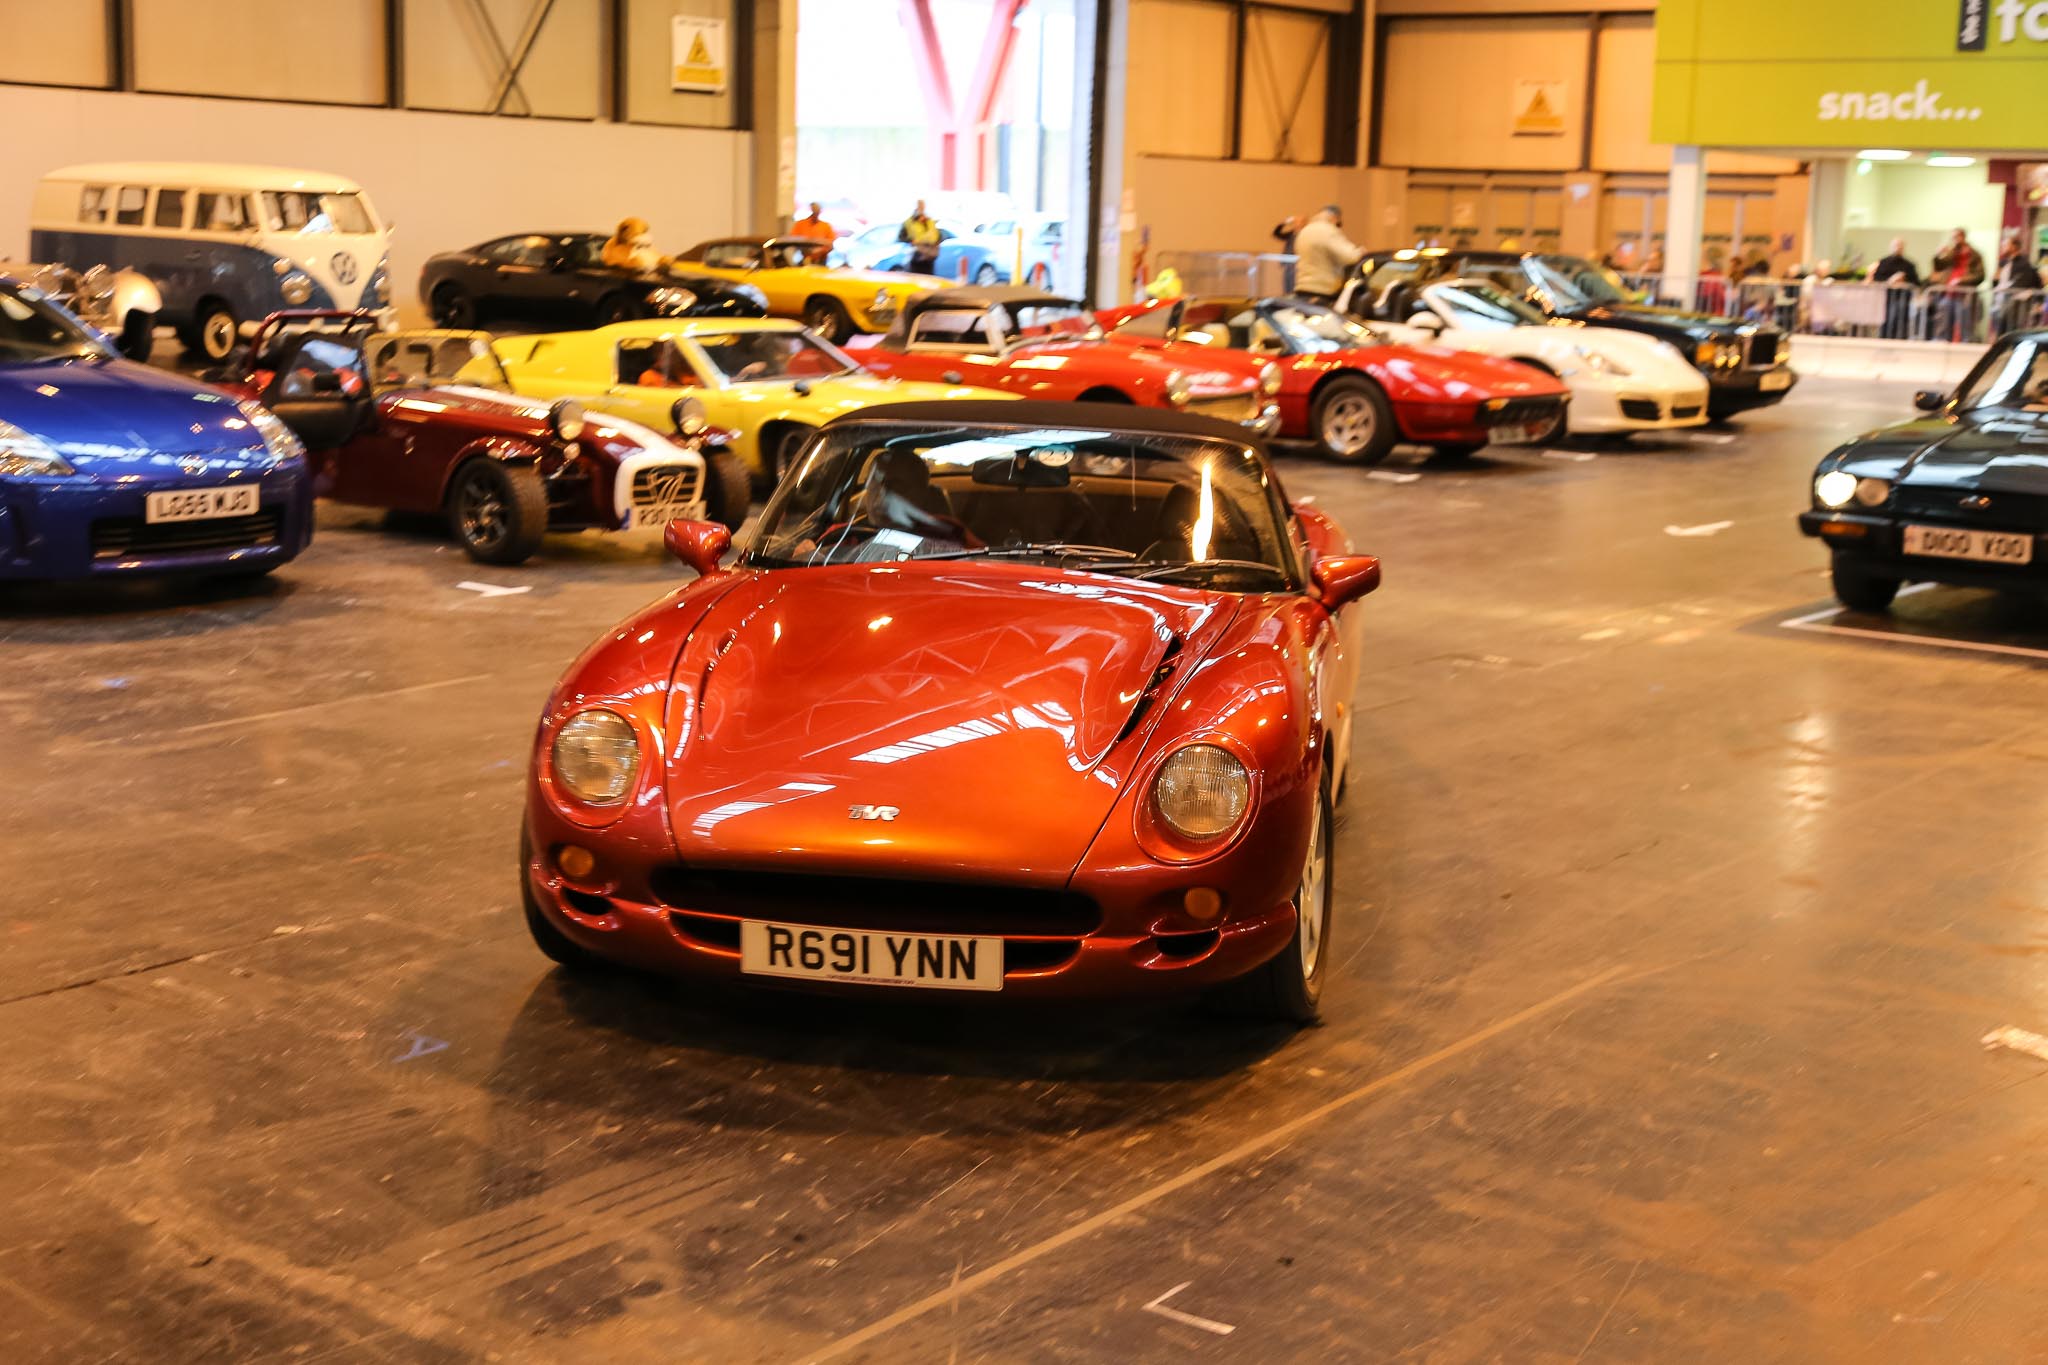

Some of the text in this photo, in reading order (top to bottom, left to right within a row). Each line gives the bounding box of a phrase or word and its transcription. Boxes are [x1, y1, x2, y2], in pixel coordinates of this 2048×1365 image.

[1817, 78, 1983, 122] snack...
[848, 804, 900, 821] TVR
[766, 924, 978, 981] R691 YNN
